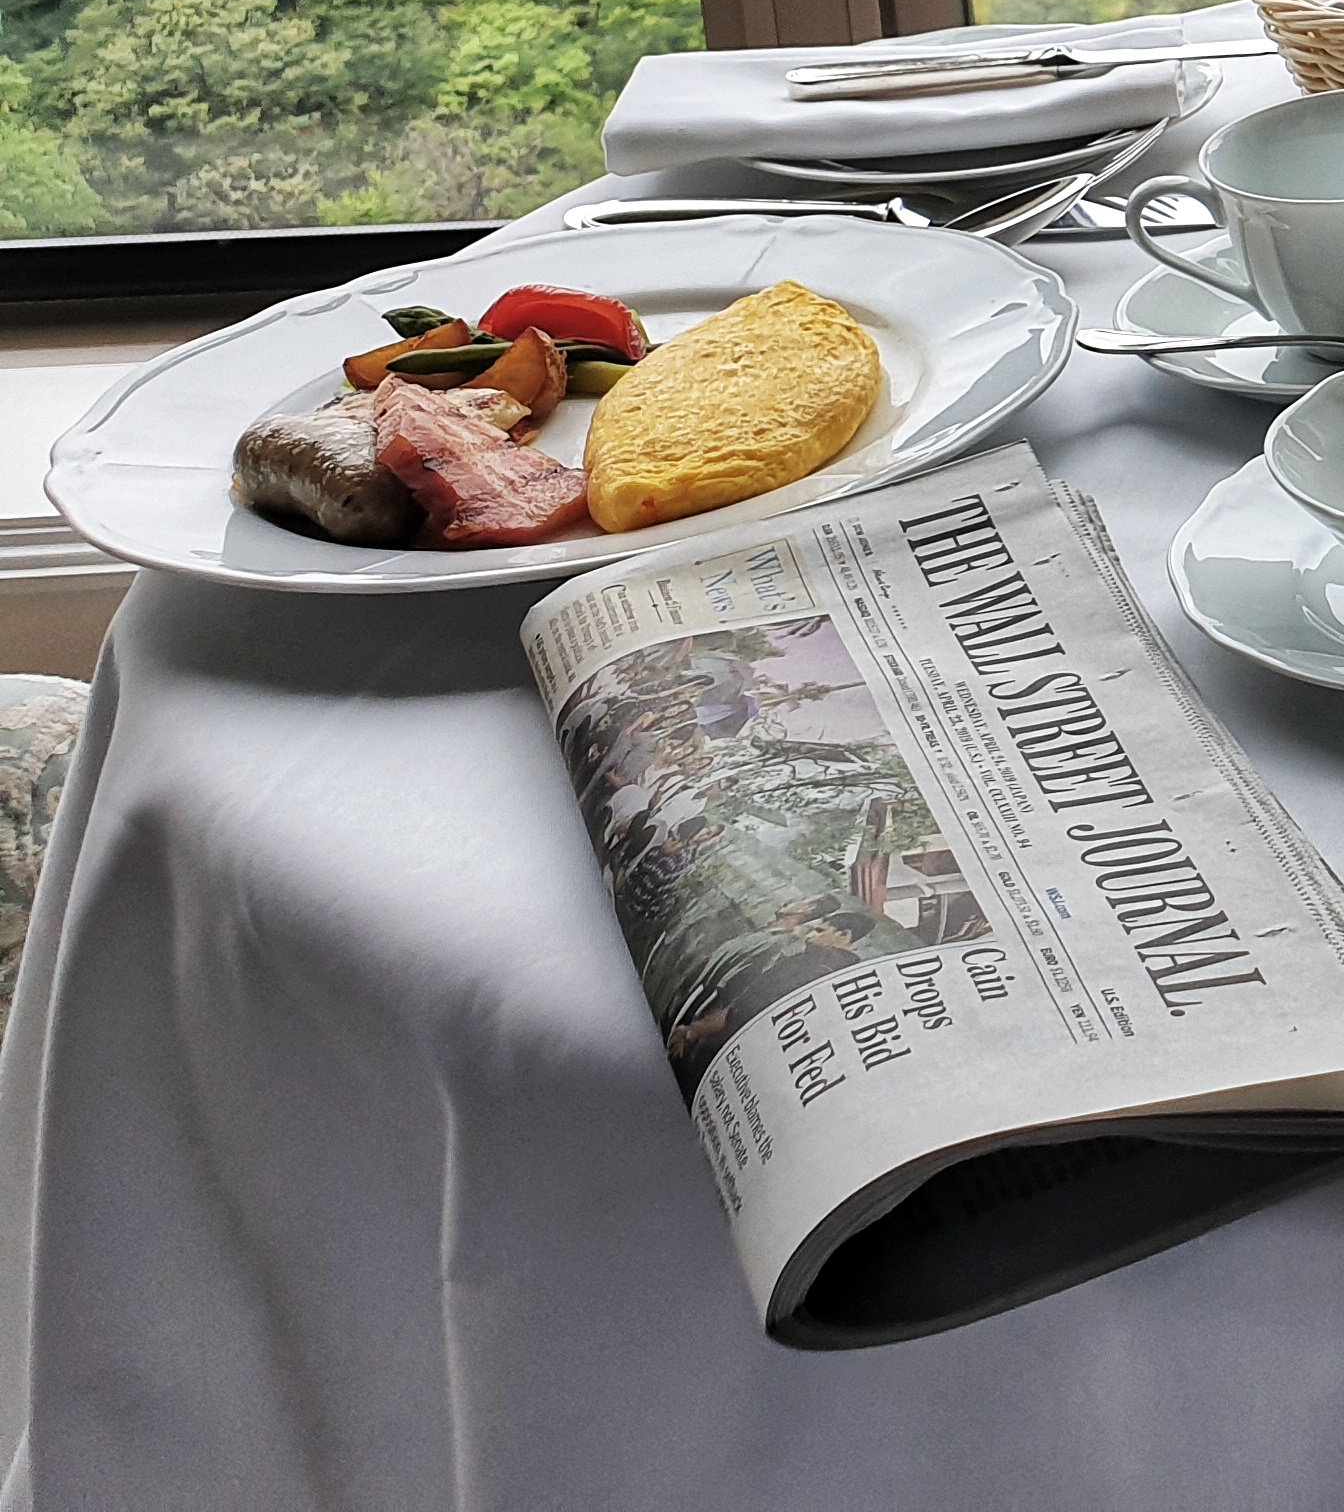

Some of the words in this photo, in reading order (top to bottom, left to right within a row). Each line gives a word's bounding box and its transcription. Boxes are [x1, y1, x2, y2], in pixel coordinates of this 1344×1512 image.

[897, 493, 1015, 588] THE
[699, 569, 737, 614] News
[743, 545, 796, 614] What's
[937, 569, 1067, 677] WALL
[953, 680, 989, 731] WEDNESDAY,
[918, 656, 945, 691] TUESDAY,
[935, 689, 960, 715] APRIL
[953, 724, 975, 744] 2019
[1015, 836, 1033, 850] 94
[978, 729, 1002, 755] APRIL
[985, 672, 1154, 814] STREET
[995, 764, 1017, 784] 2019
[1004, 780, 1034, 815] (JAPAN)
[960, 947, 1016, 1002] Cain
[1038, 946, 1059, 967] EURO
[831, 969, 884, 1022] His
[895, 955, 955, 1031] Drops
[1069, 1002, 1087, 1020] YEN
[1099, 986, 1120, 1006] U.S.
[770, 993, 818, 1053] For
[850, 1014, 912, 1072] Bid
[1108, 1003, 1138, 1039] Edition
[787, 1039, 846, 1108] Fed
[725, 1043, 750, 1104] Executive
[741, 1093, 765, 1143] blames
[756, 1135, 774, 1165] the
